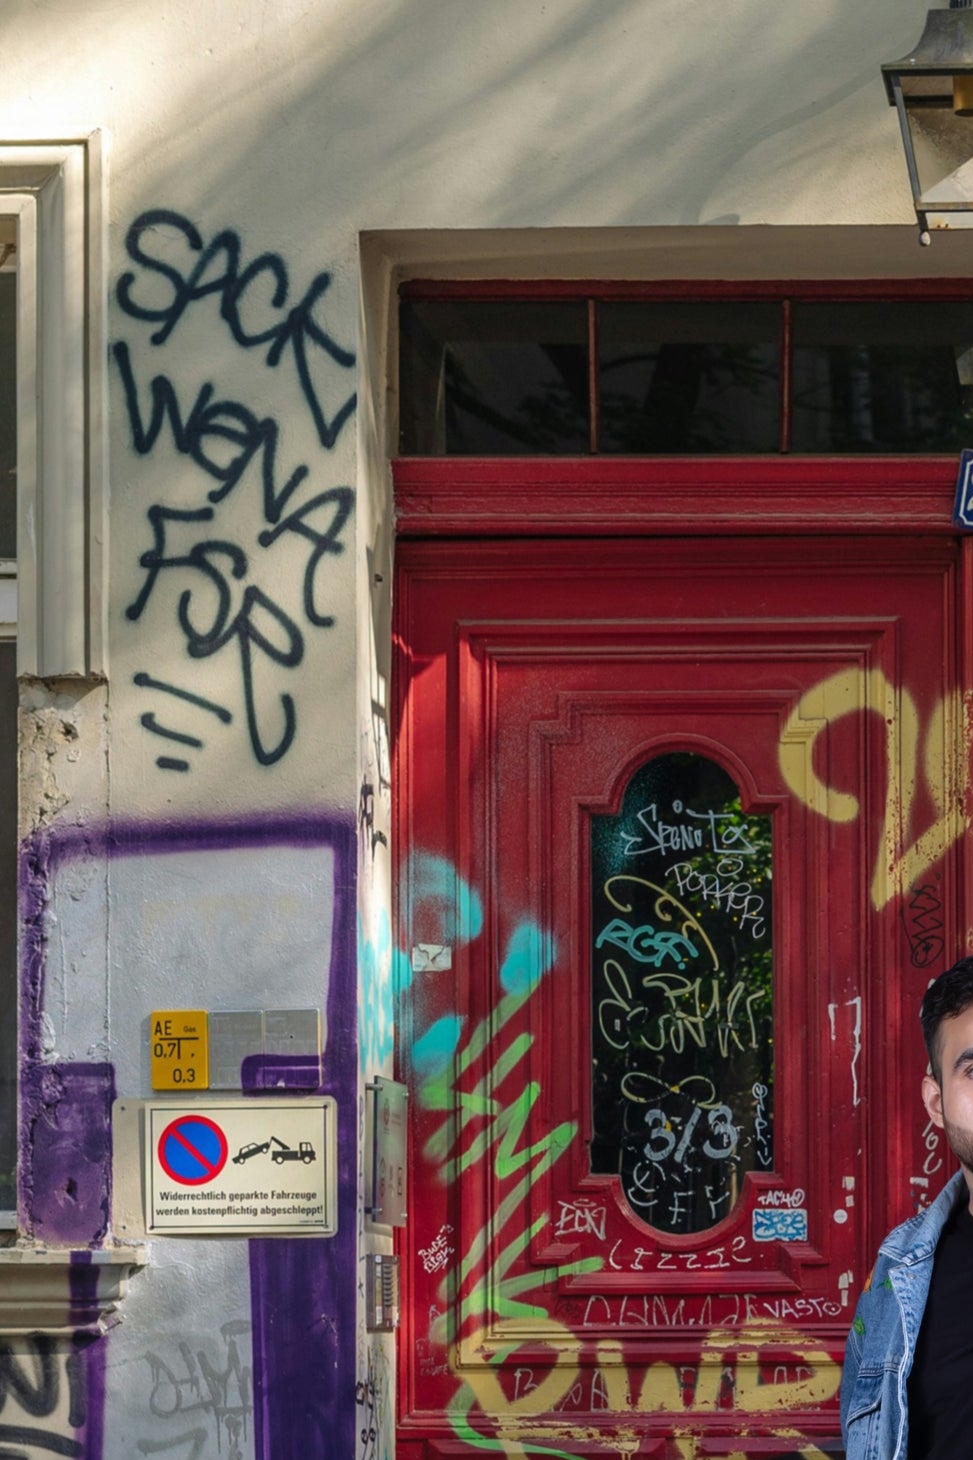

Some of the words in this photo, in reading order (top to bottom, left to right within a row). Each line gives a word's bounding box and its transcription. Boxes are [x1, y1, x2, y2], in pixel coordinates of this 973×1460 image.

[154, 1020, 172, 1036] AE
[183, 1025, 196, 1033] Gas
[159, 1191, 227, 1200] Widerrechtlich
[228, 1191, 269, 1202] geparkte
[271, 1190, 318, 1201] Fahrzeuge
[156, 1206, 190, 1216] werden
[191, 1205, 259, 1217] kostenpflichtig
[260, 1204, 324, 1216] abgeschleppt!
